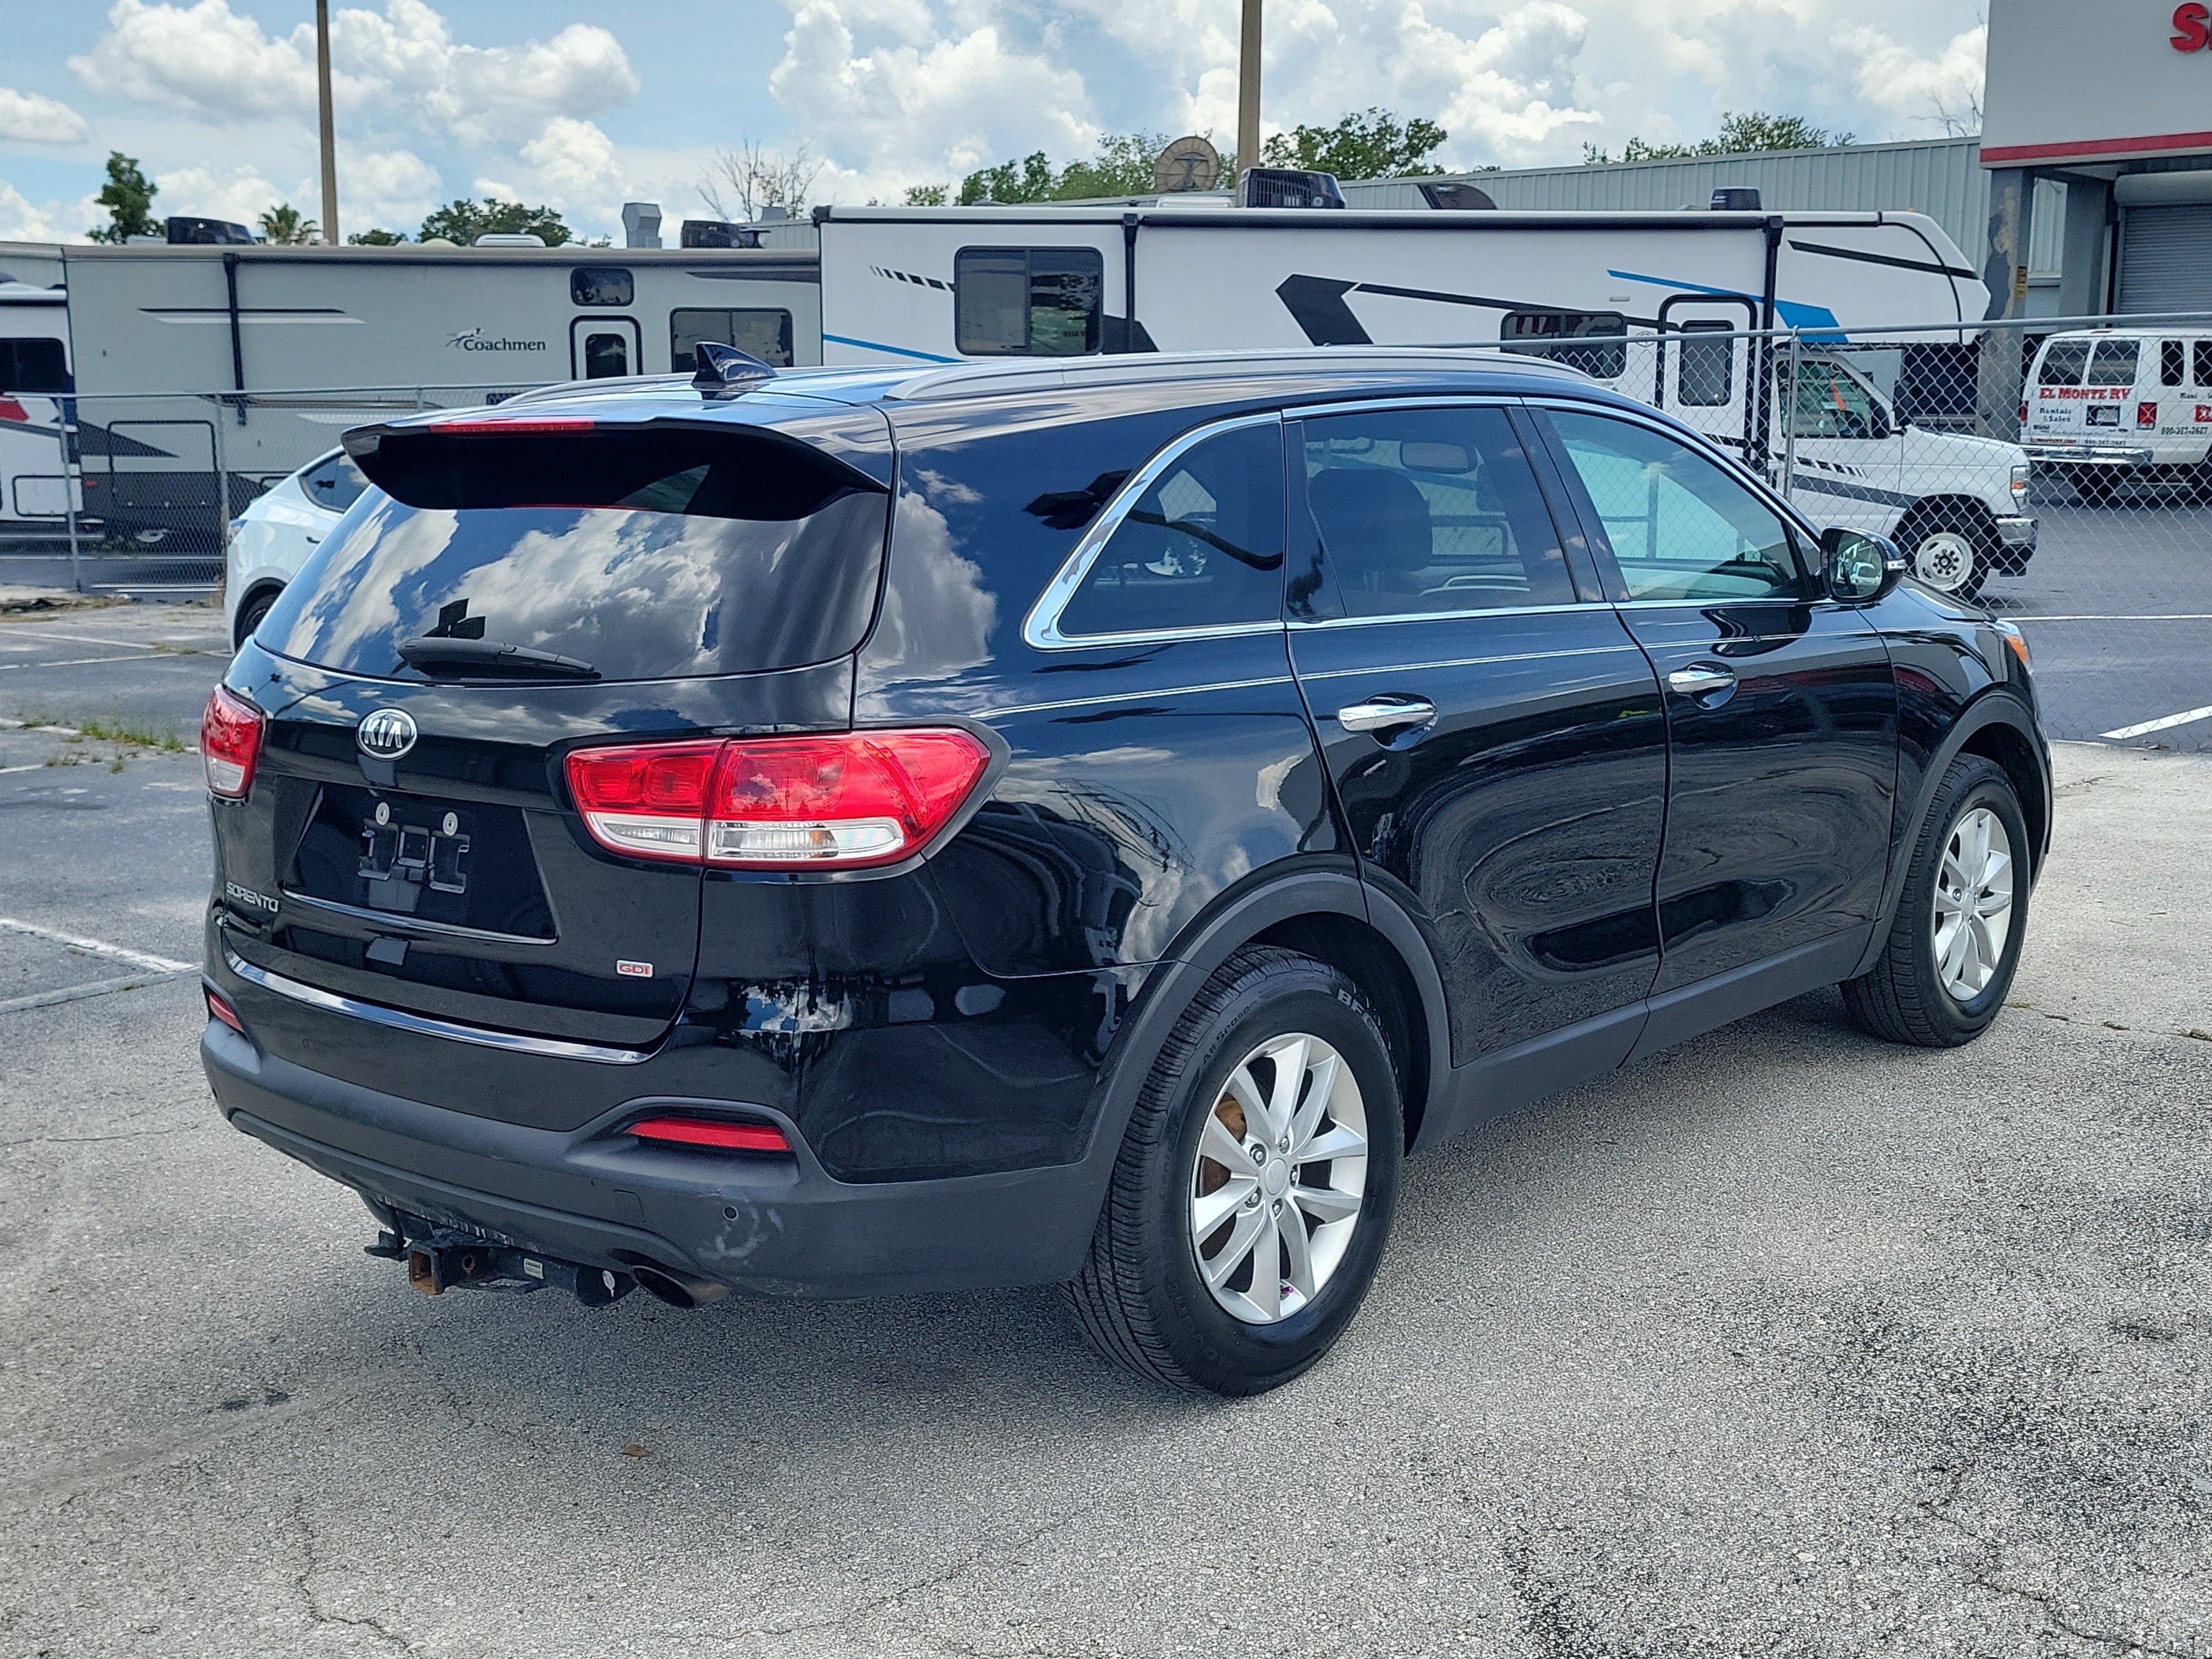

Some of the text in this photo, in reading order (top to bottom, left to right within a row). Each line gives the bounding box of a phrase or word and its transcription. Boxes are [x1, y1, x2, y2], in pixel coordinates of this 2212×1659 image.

[2170, 2, 2212, 53] S
[464, 337, 546, 351] Coachmen
[2039, 387, 2132, 399] EL MONTE RV
[364, 718, 403, 749] KIA
[226, 881, 279, 913] SORENTO
[619, 964, 650, 975] GDI
